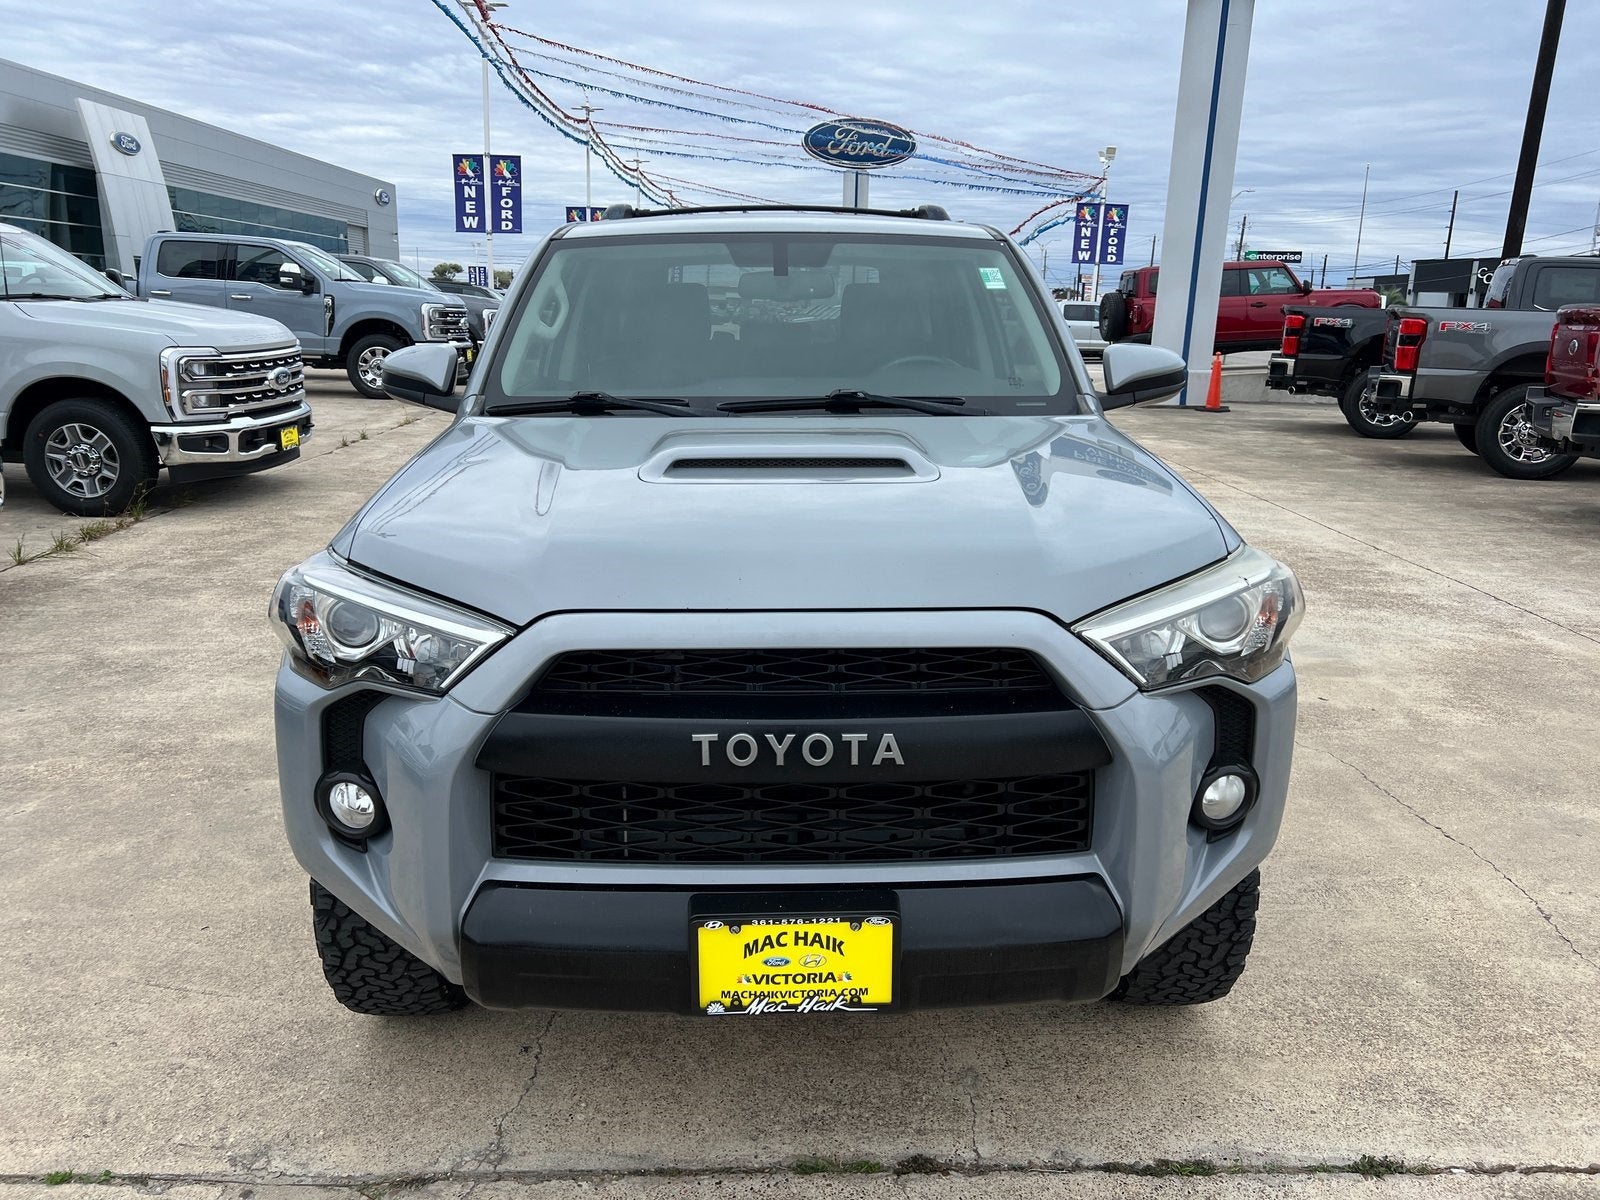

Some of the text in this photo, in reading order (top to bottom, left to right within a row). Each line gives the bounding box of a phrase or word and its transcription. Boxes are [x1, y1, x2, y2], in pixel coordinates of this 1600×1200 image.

[827, 126, 893, 157] Ford
[462, 185, 479, 229] NEW
[500, 186, 513, 231] FORD
[1077, 226, 1092, 261] NEW
[1106, 228, 1119, 263] FORD
[1246, 252, 1301, 262] enterprise
[1314, 317, 1353, 328] FX4
[1439, 320, 1492, 332] FX4
[692, 733, 905, 767] TOYOTA
[743, 931, 845, 959] MAC HAIK
[752, 971, 837, 985] VICTORIA
[720, 987, 869, 999] MACHAIKVICTORIACOM
[744, 995, 850, 1015] Mac Haik
